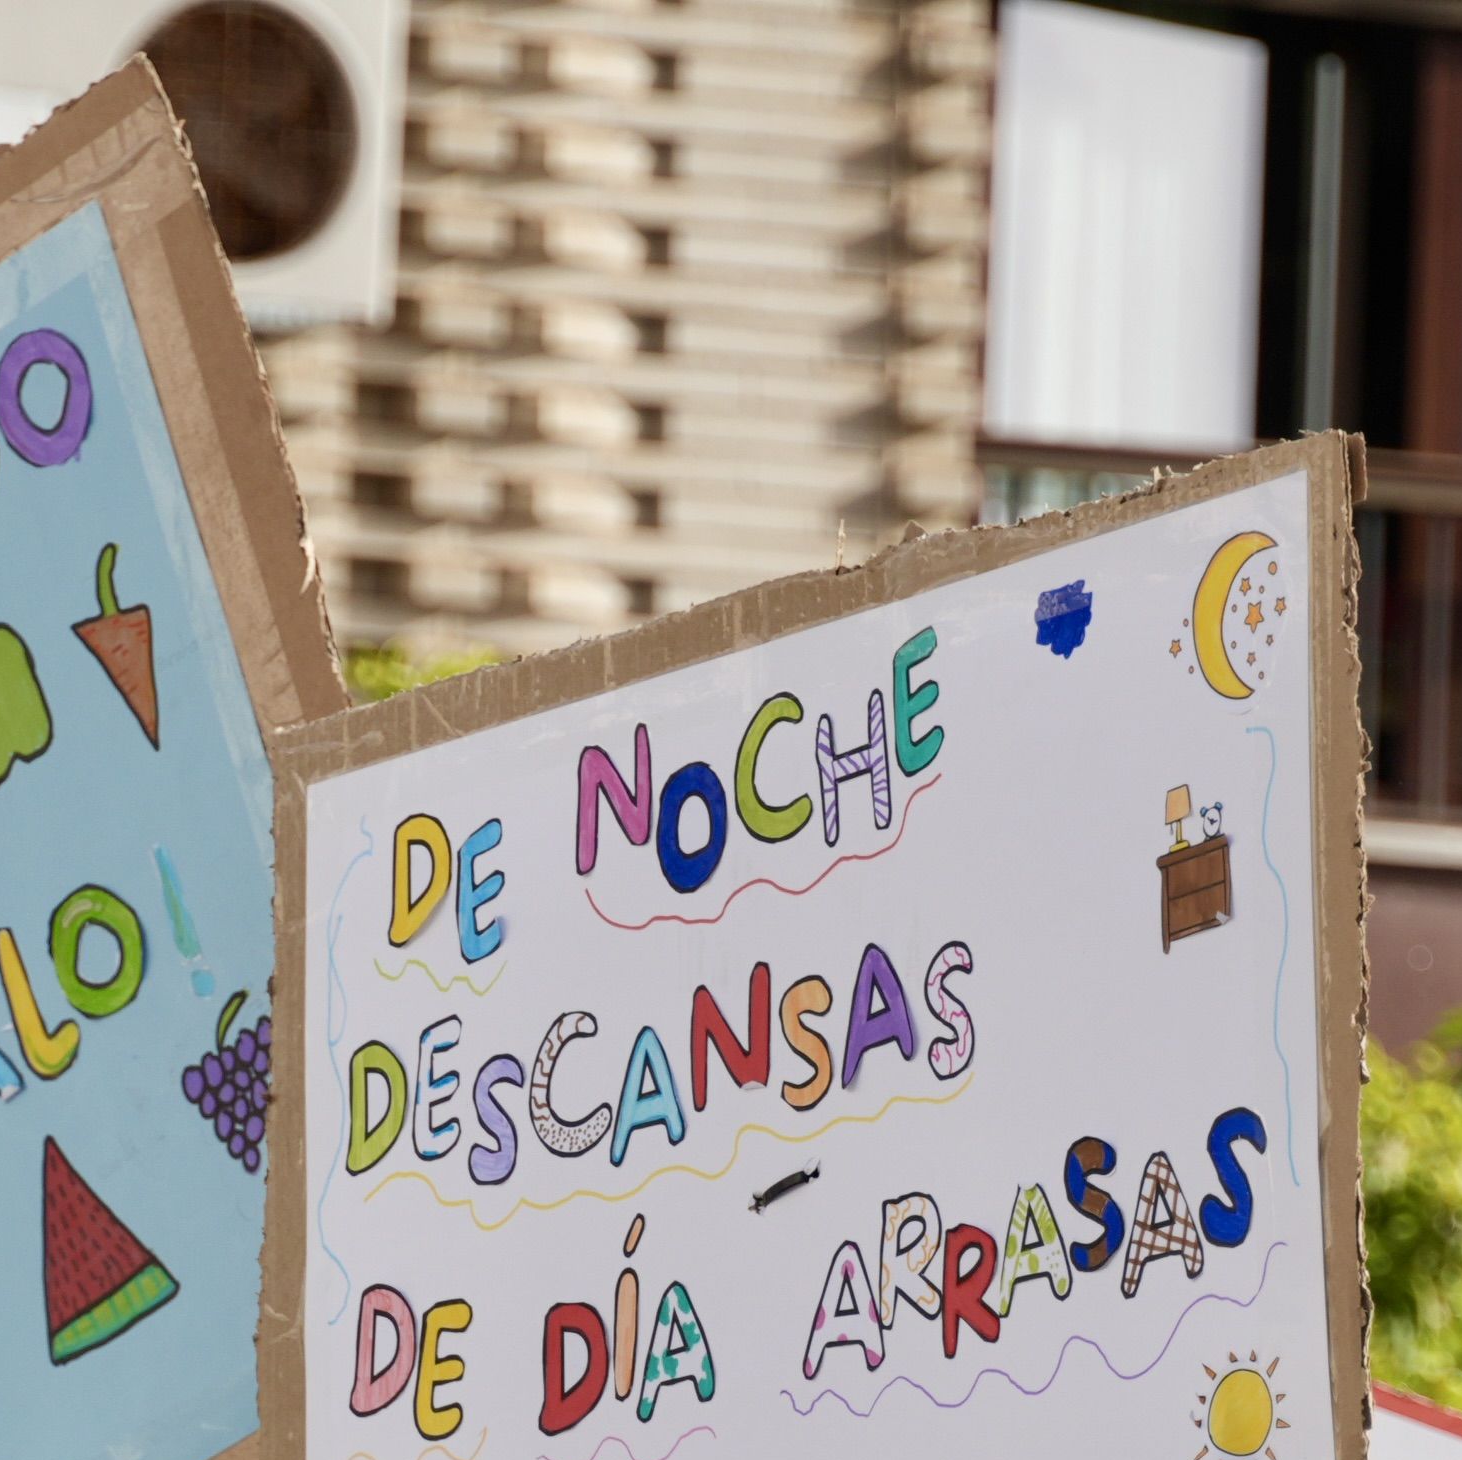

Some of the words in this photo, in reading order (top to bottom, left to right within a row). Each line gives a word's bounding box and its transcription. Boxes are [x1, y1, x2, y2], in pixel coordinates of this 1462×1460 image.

[388, 813, 505, 963] DE
[575, 626, 945, 893] NOCHE
[346, 941, 976, 1185] DESCANSAS
[350, 1284, 473, 1441] DE
[538, 1213, 715, 1436] DÍA
[803, 1107, 1267, 1381] ARRASAS
